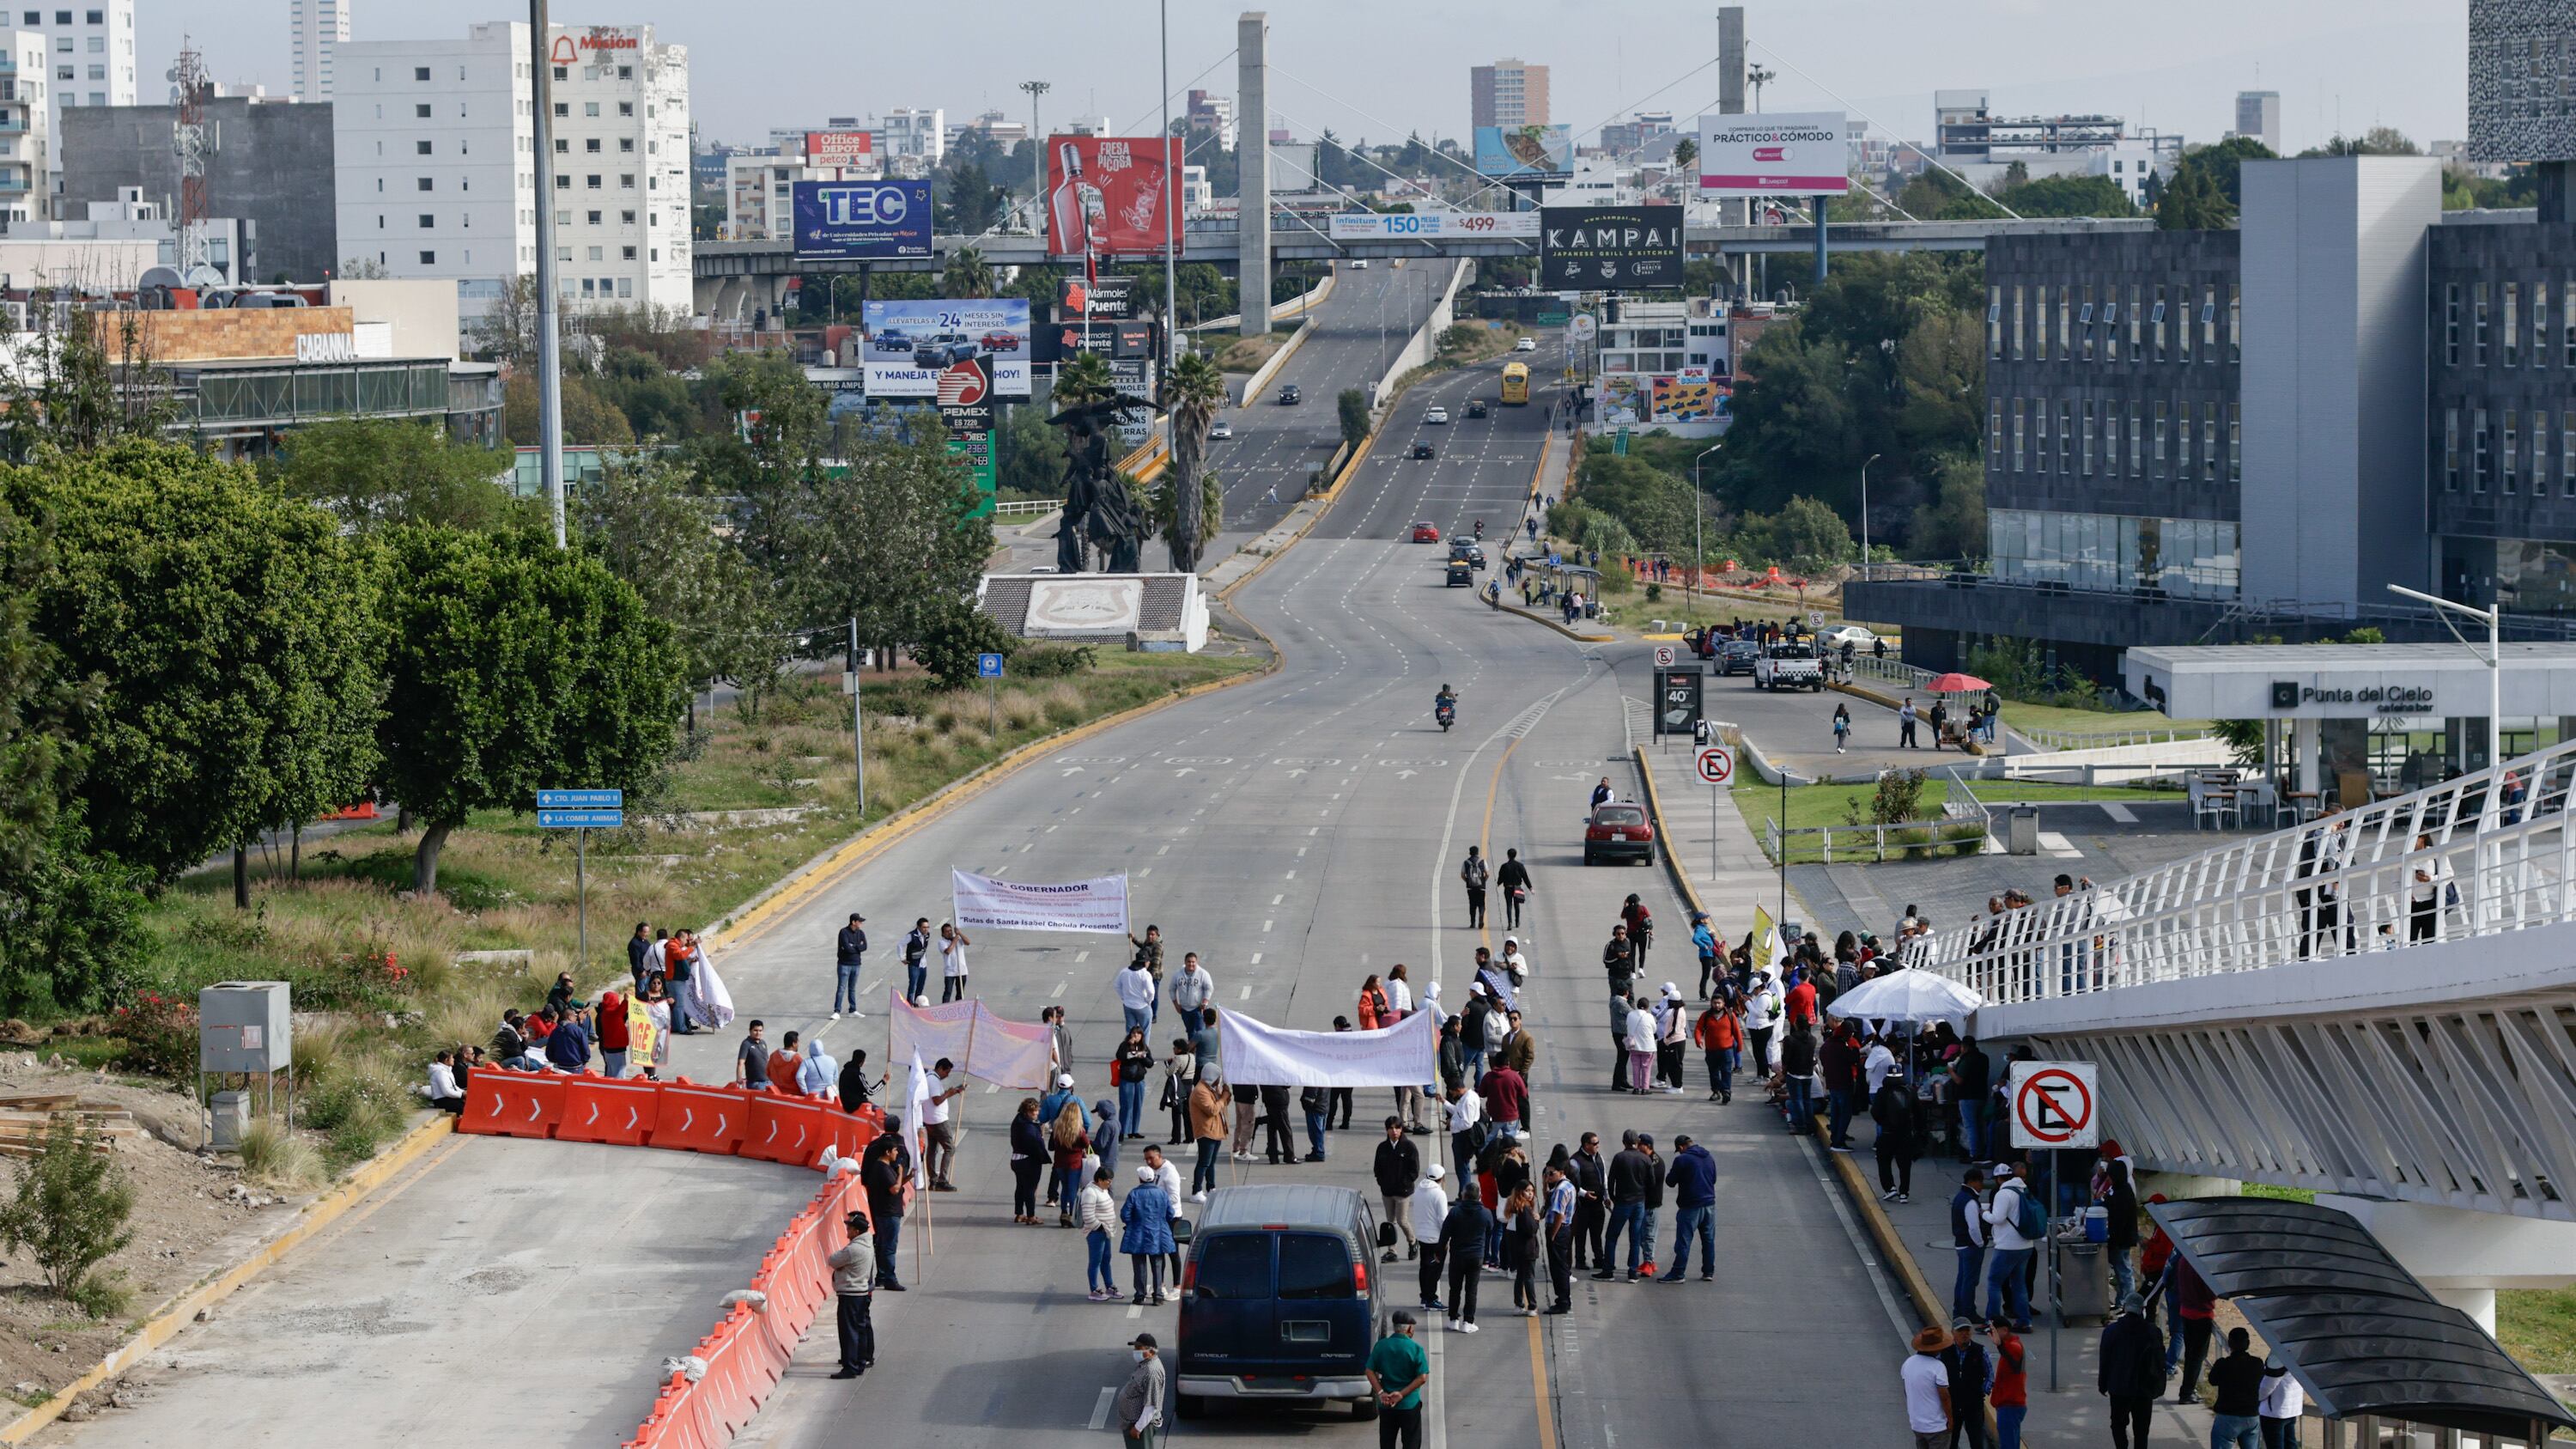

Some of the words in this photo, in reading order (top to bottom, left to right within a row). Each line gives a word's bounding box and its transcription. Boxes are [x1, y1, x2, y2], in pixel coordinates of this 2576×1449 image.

[580, 34, 637, 49] Misión
[821, 135, 860, 145] Office
[1100, 142, 1130, 155] FRESA
[819, 155, 848, 165] petco
[1097, 153, 1133, 172] PICOSA
[818, 186, 907, 224] TEC
[1382, 216, 1419, 234] 150
[1459, 217, 1494, 231] $499
[1547, 227, 1679, 247] KAMPAI
[1088, 289, 1127, 298] Mármoles
[1088, 300, 1127, 312] Puente
[939, 313, 962, 327] 24
[296, 333, 353, 362] CABANNA
[875, 371, 883, 380] Y
[885, 370, 924, 379] MANEJA
[943, 407, 988, 417] PEMEX
[2303, 687, 2353, 702] Punta
[2358, 686, 2384, 702] del
[2388, 685, 2433, 702] Cielo
[2415, 703, 2433, 712] bar
[1707, 755, 1722, 776] E
[990, 880, 1007, 888] SR.
[1010, 884, 1089, 892] GOBERNADOR
[2038, 1086, 2070, 1129] E
